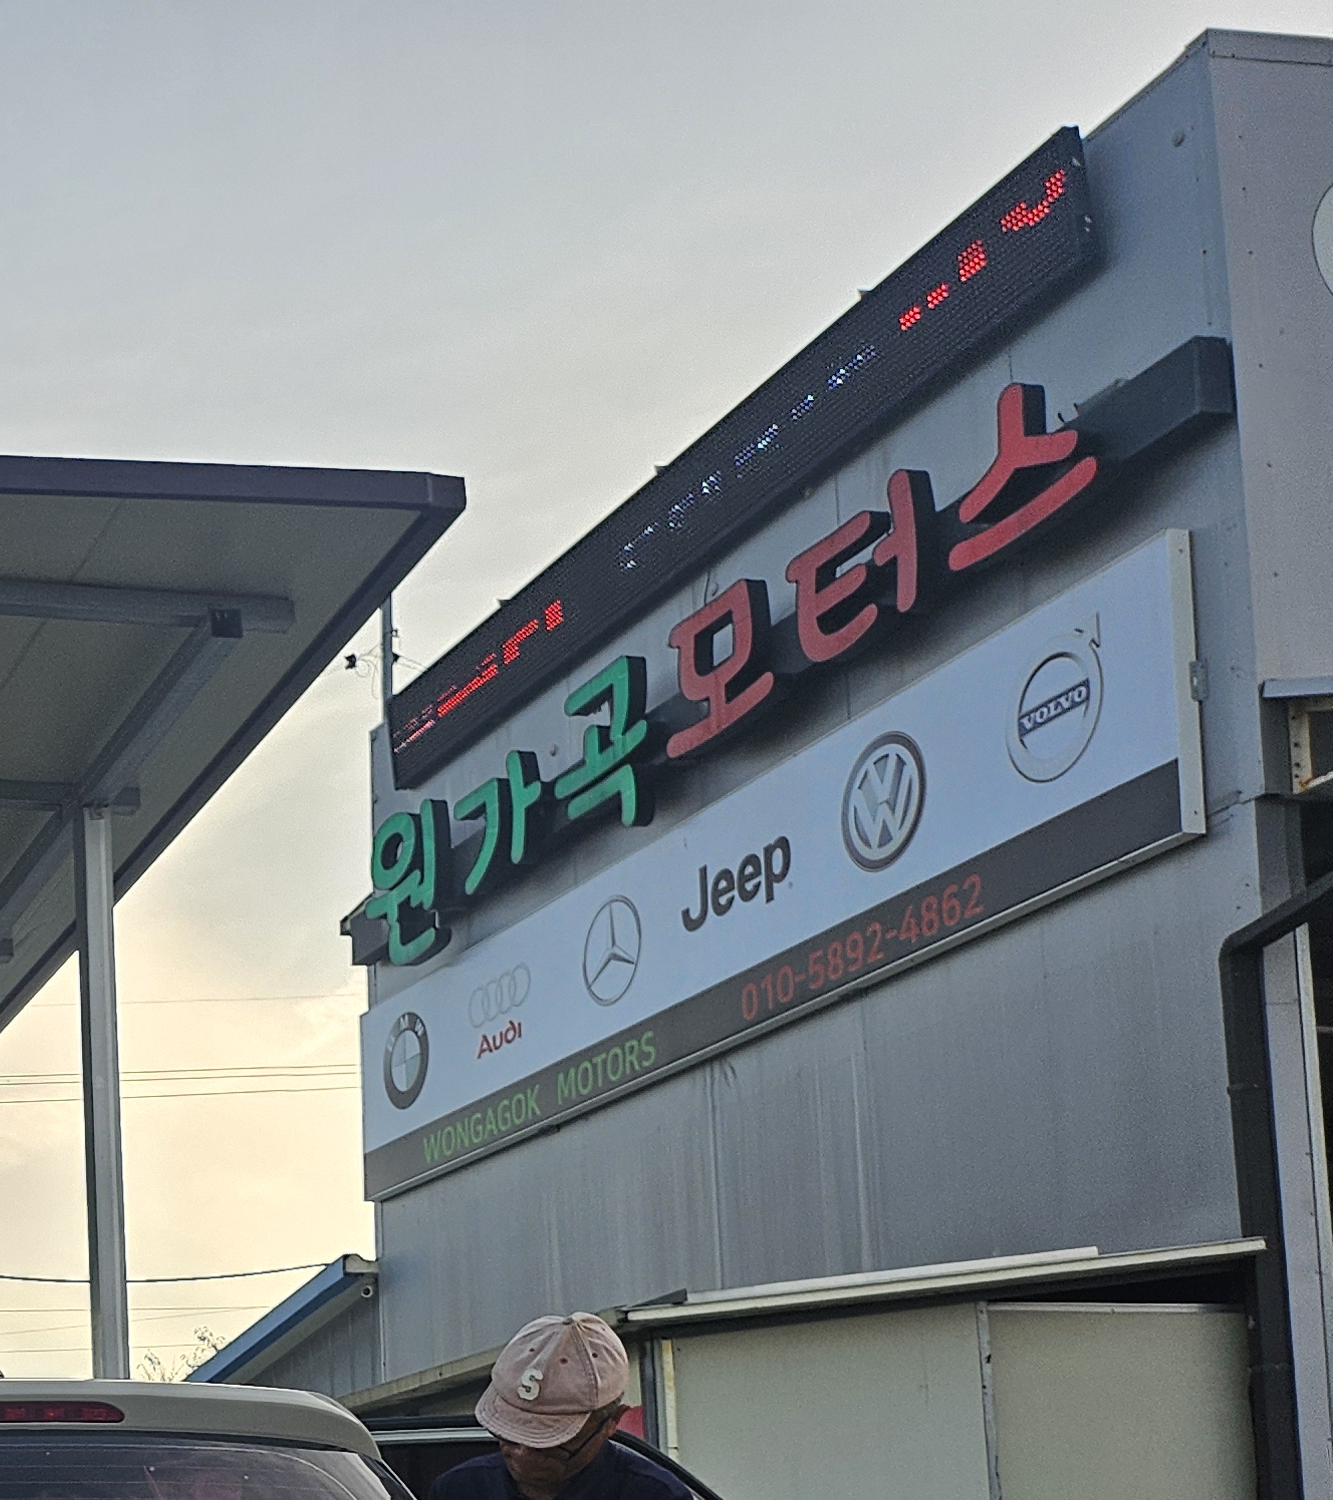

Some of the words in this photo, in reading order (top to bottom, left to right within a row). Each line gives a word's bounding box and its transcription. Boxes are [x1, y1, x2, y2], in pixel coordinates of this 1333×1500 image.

[1019, 685, 1087, 730] VOLVO
[681, 836, 792, 932] Jeep
[741, 873, 984, 1020] 010-5892-4862
[476, 1019, 523, 1060] Audi
[422, 1084, 541, 1166] WONGAGOK
[556, 1030, 657, 1105] MOTORS
[517, 1368, 544, 1401] S
